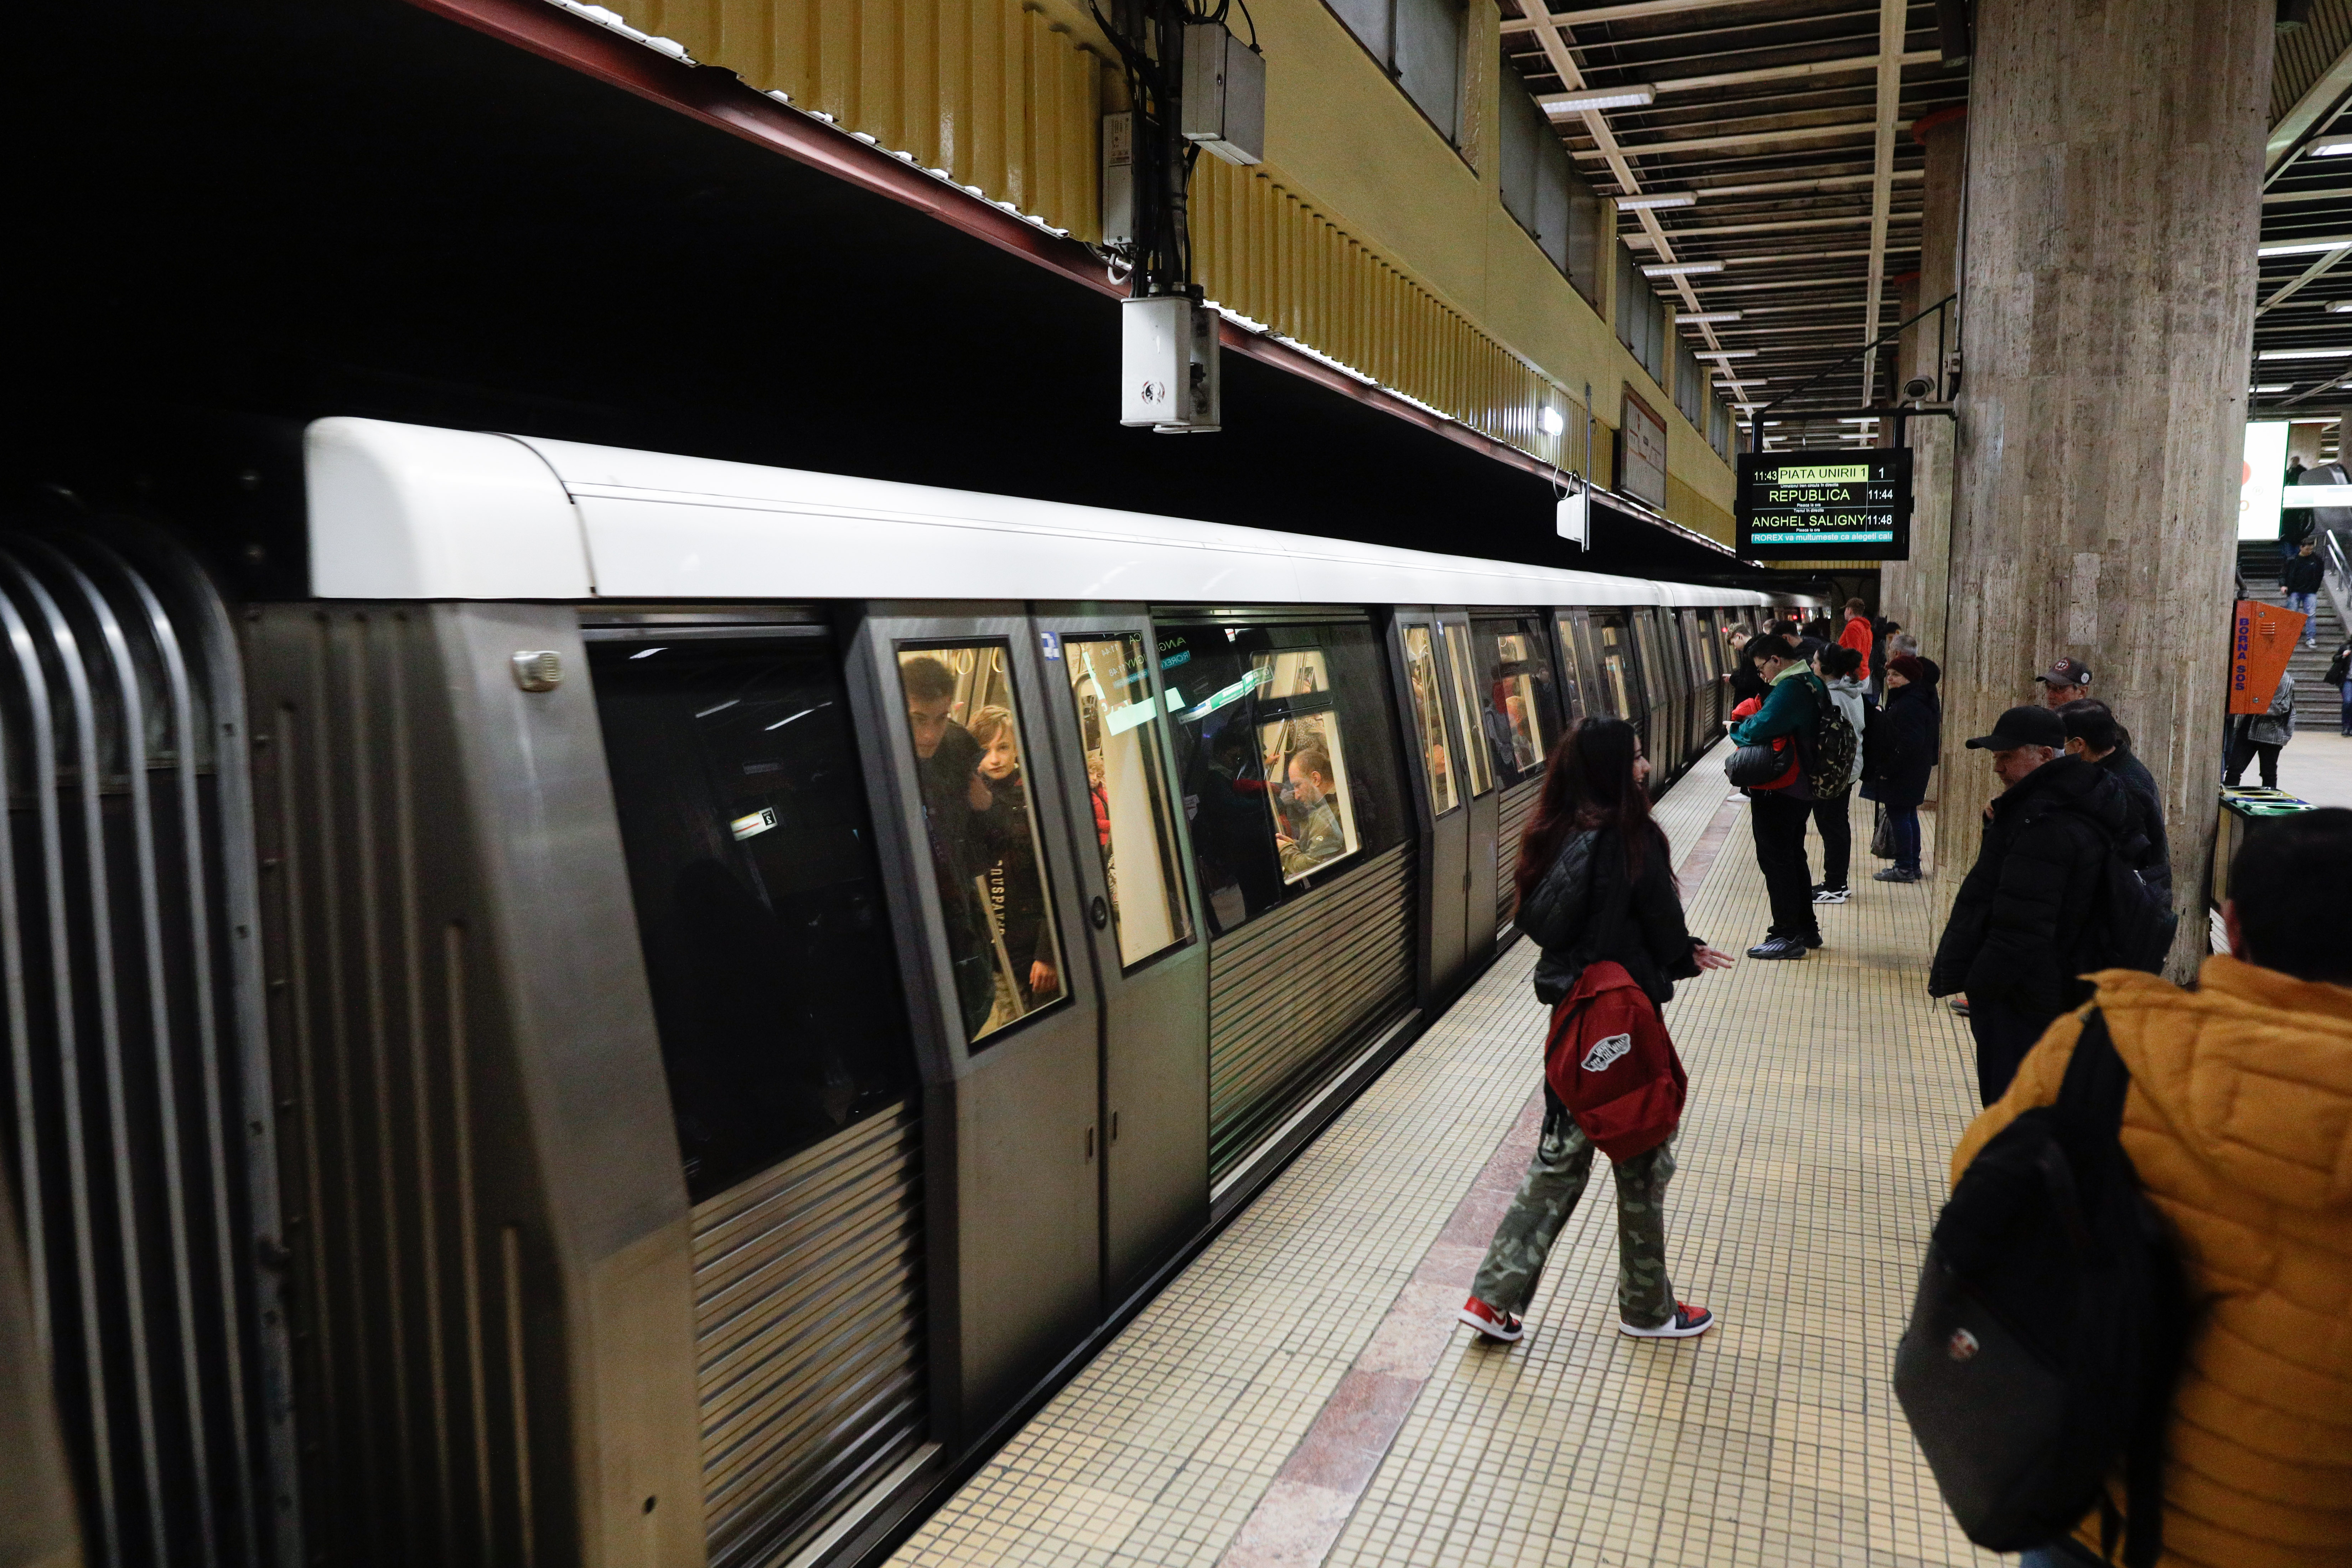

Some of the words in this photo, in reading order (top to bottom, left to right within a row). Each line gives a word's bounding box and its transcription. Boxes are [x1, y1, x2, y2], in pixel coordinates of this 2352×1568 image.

[1755, 471, 1777, 481] 11:43
[1780, 469, 1815, 479] PIATA
[1819, 468, 1856, 478] UNIRII
[1861, 467, 1865, 477] 1
[1879, 467, 1884, 478] 1
[1770, 488, 1850, 502] REPUBLICA
[1869, 489, 1893, 500] 11:44
[1752, 516, 1805, 527] ANGHEL
[1809, 514, 1866, 526] SALIGNY
[1867, 514, 1892, 525] 11:48
[1851, 533, 1876, 542] alegeti
[2237, 618, 2249, 659] BORNA
[2235, 665, 2246, 690] SOS
